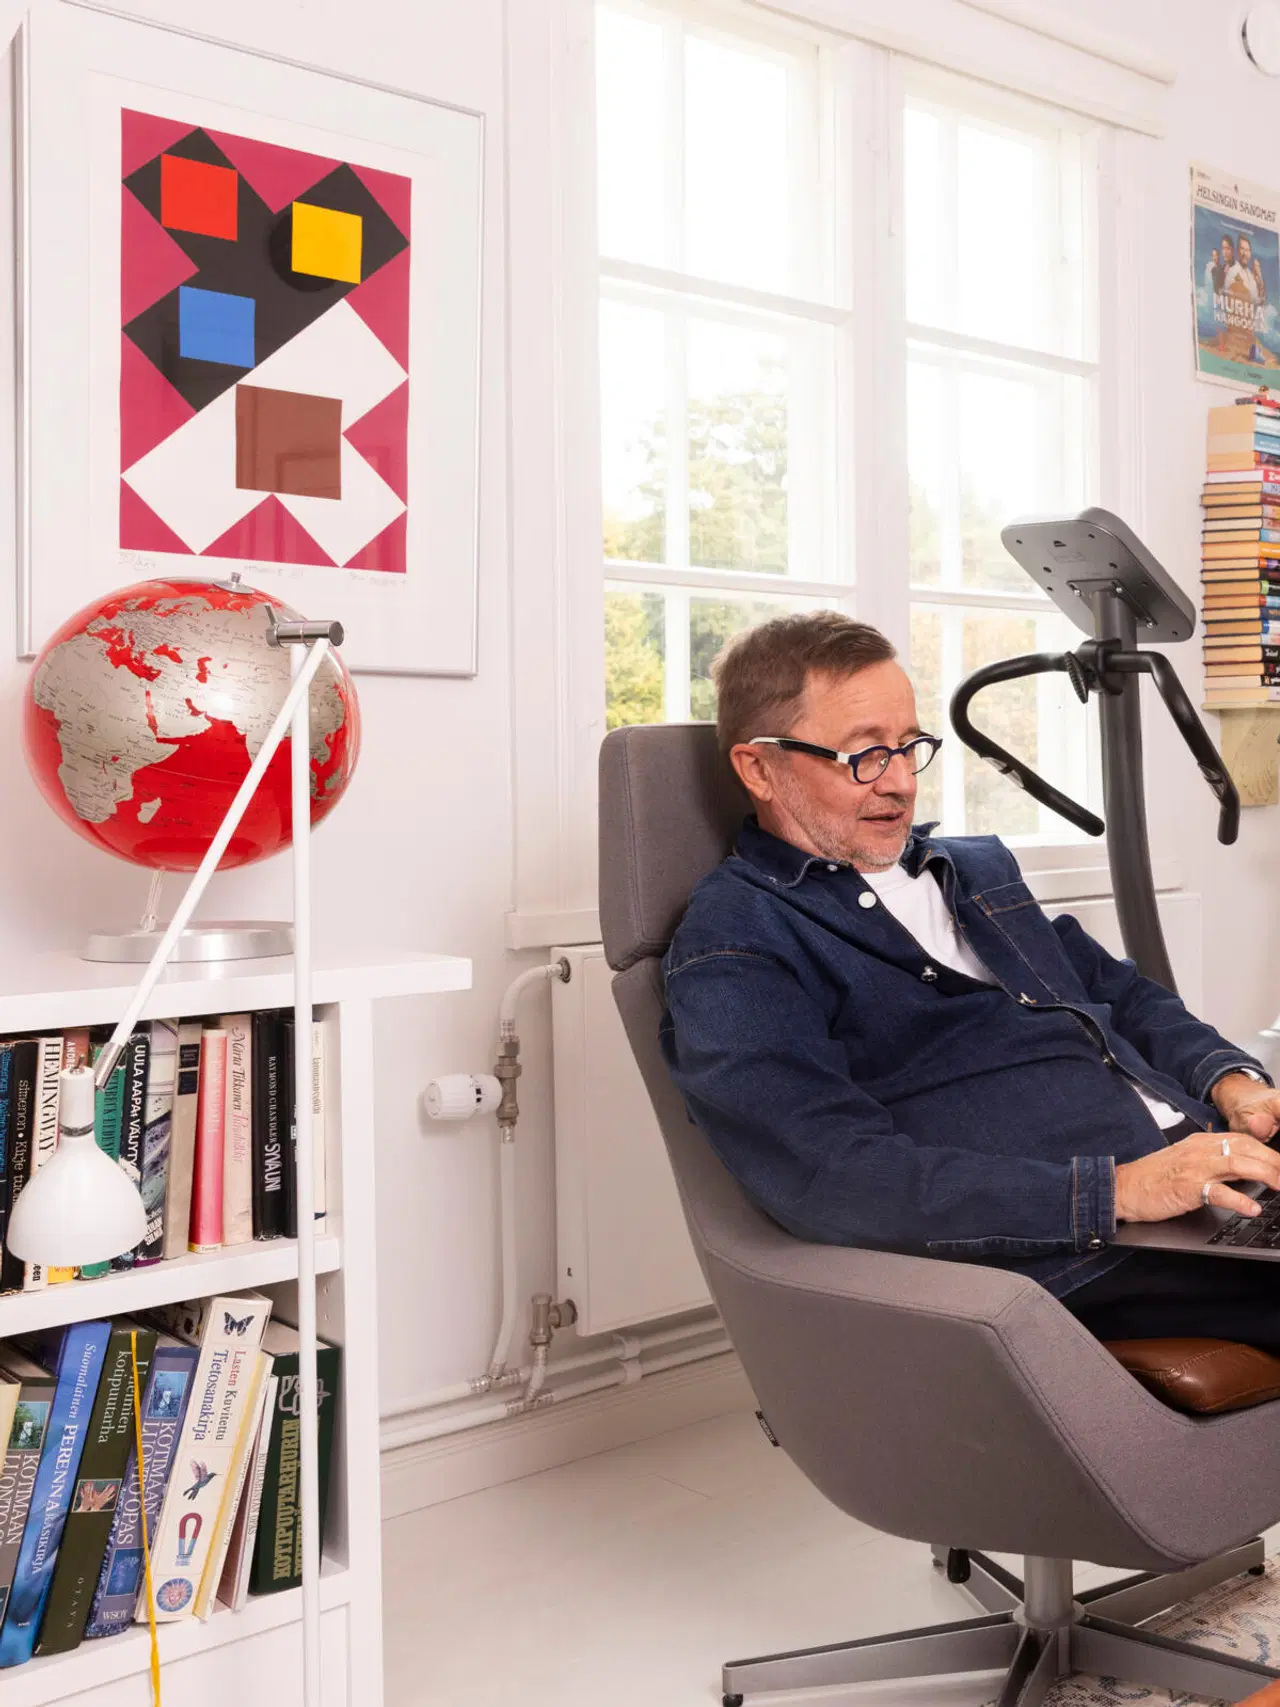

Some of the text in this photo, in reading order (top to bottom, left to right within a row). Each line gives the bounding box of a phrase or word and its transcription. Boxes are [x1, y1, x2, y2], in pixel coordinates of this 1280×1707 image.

[39, 1043, 61, 1152] HEMINGWAY
[133, 1045, 146, 1077] UULA
[232, 1068, 247, 1111] Tikkanen
[18, 1079, 29, 1134] simenon
[268, 1056, 278, 1143] RAYMOND CHANDLER
[12, 1141, 27, 1171] Kirje
[69, 1343, 97, 1419] Suomalainen
[98, 1350, 133, 1444] kotipuutarha
[192, 1349, 229, 1442] Tietosanakirja
[228, 1350, 247, 1386] Lasten
[216, 1390, 238, 1441] Kuvitettu
[6, 1453, 41, 1545] KOTIMAAN
[144, 1421, 177, 1515] KOTIMAAN
[273, 1419, 301, 1581] KOTIPUUTARHURIN
[66, 1576, 84, 1629] OTAVA
